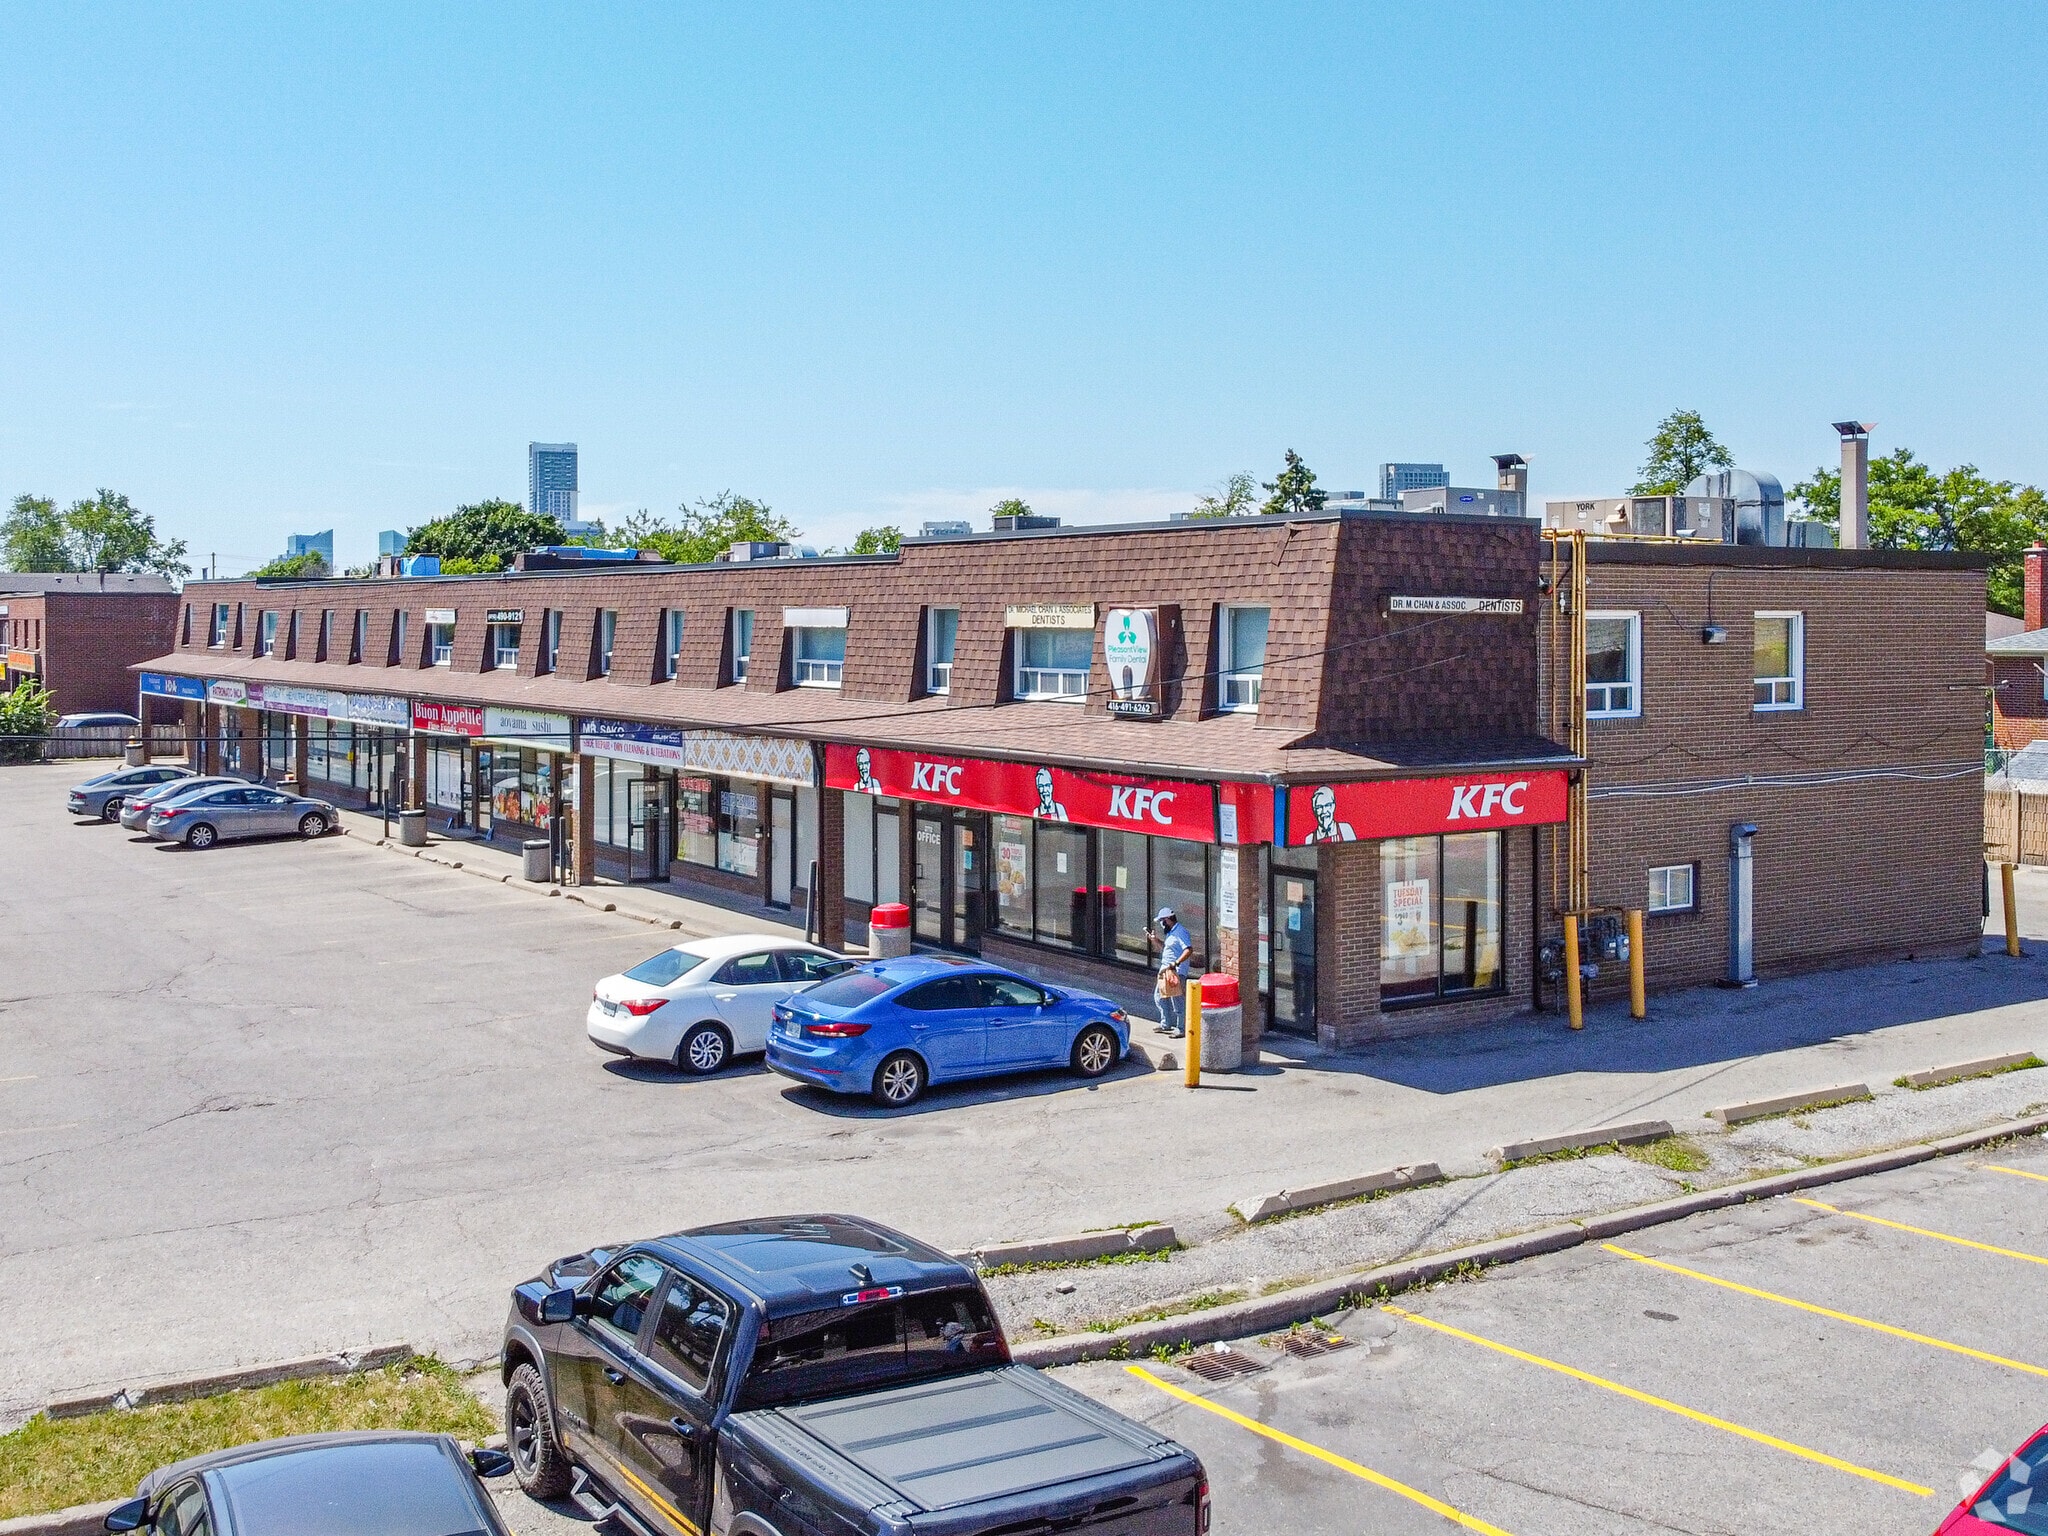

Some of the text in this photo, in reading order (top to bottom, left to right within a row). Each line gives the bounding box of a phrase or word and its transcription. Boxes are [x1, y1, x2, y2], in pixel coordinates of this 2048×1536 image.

[1576, 503, 1595, 511] YORK
[1016, 605, 1037, 614] MICHAEL
[1038, 605, 1053, 614] CHAN
[1059, 605, 1092, 614] ASSOCIATES
[1414, 601, 1433, 609] CHAN
[1435, 601, 1440, 609] &
[1479, 601, 1521, 612] DENTISTS
[1032, 615, 1066, 625] DENTISTS
[1109, 654, 1147, 664] Family Dental
[532, 717, 551, 733] sushi
[600, 726, 624, 738] SAKO
[624, 743, 645, 755] CLEANING
[650, 747, 681, 760] ALTERATIONS
[911, 761, 964, 795] KFC
[1107, 784, 1174, 825] KFC
[1446, 781, 1529, 820] KFC
[917, 831, 941, 845] OFFICE
[1393, 886, 1424, 898] TUESDAY
[1393, 897, 1424, 908] SPECIAL
